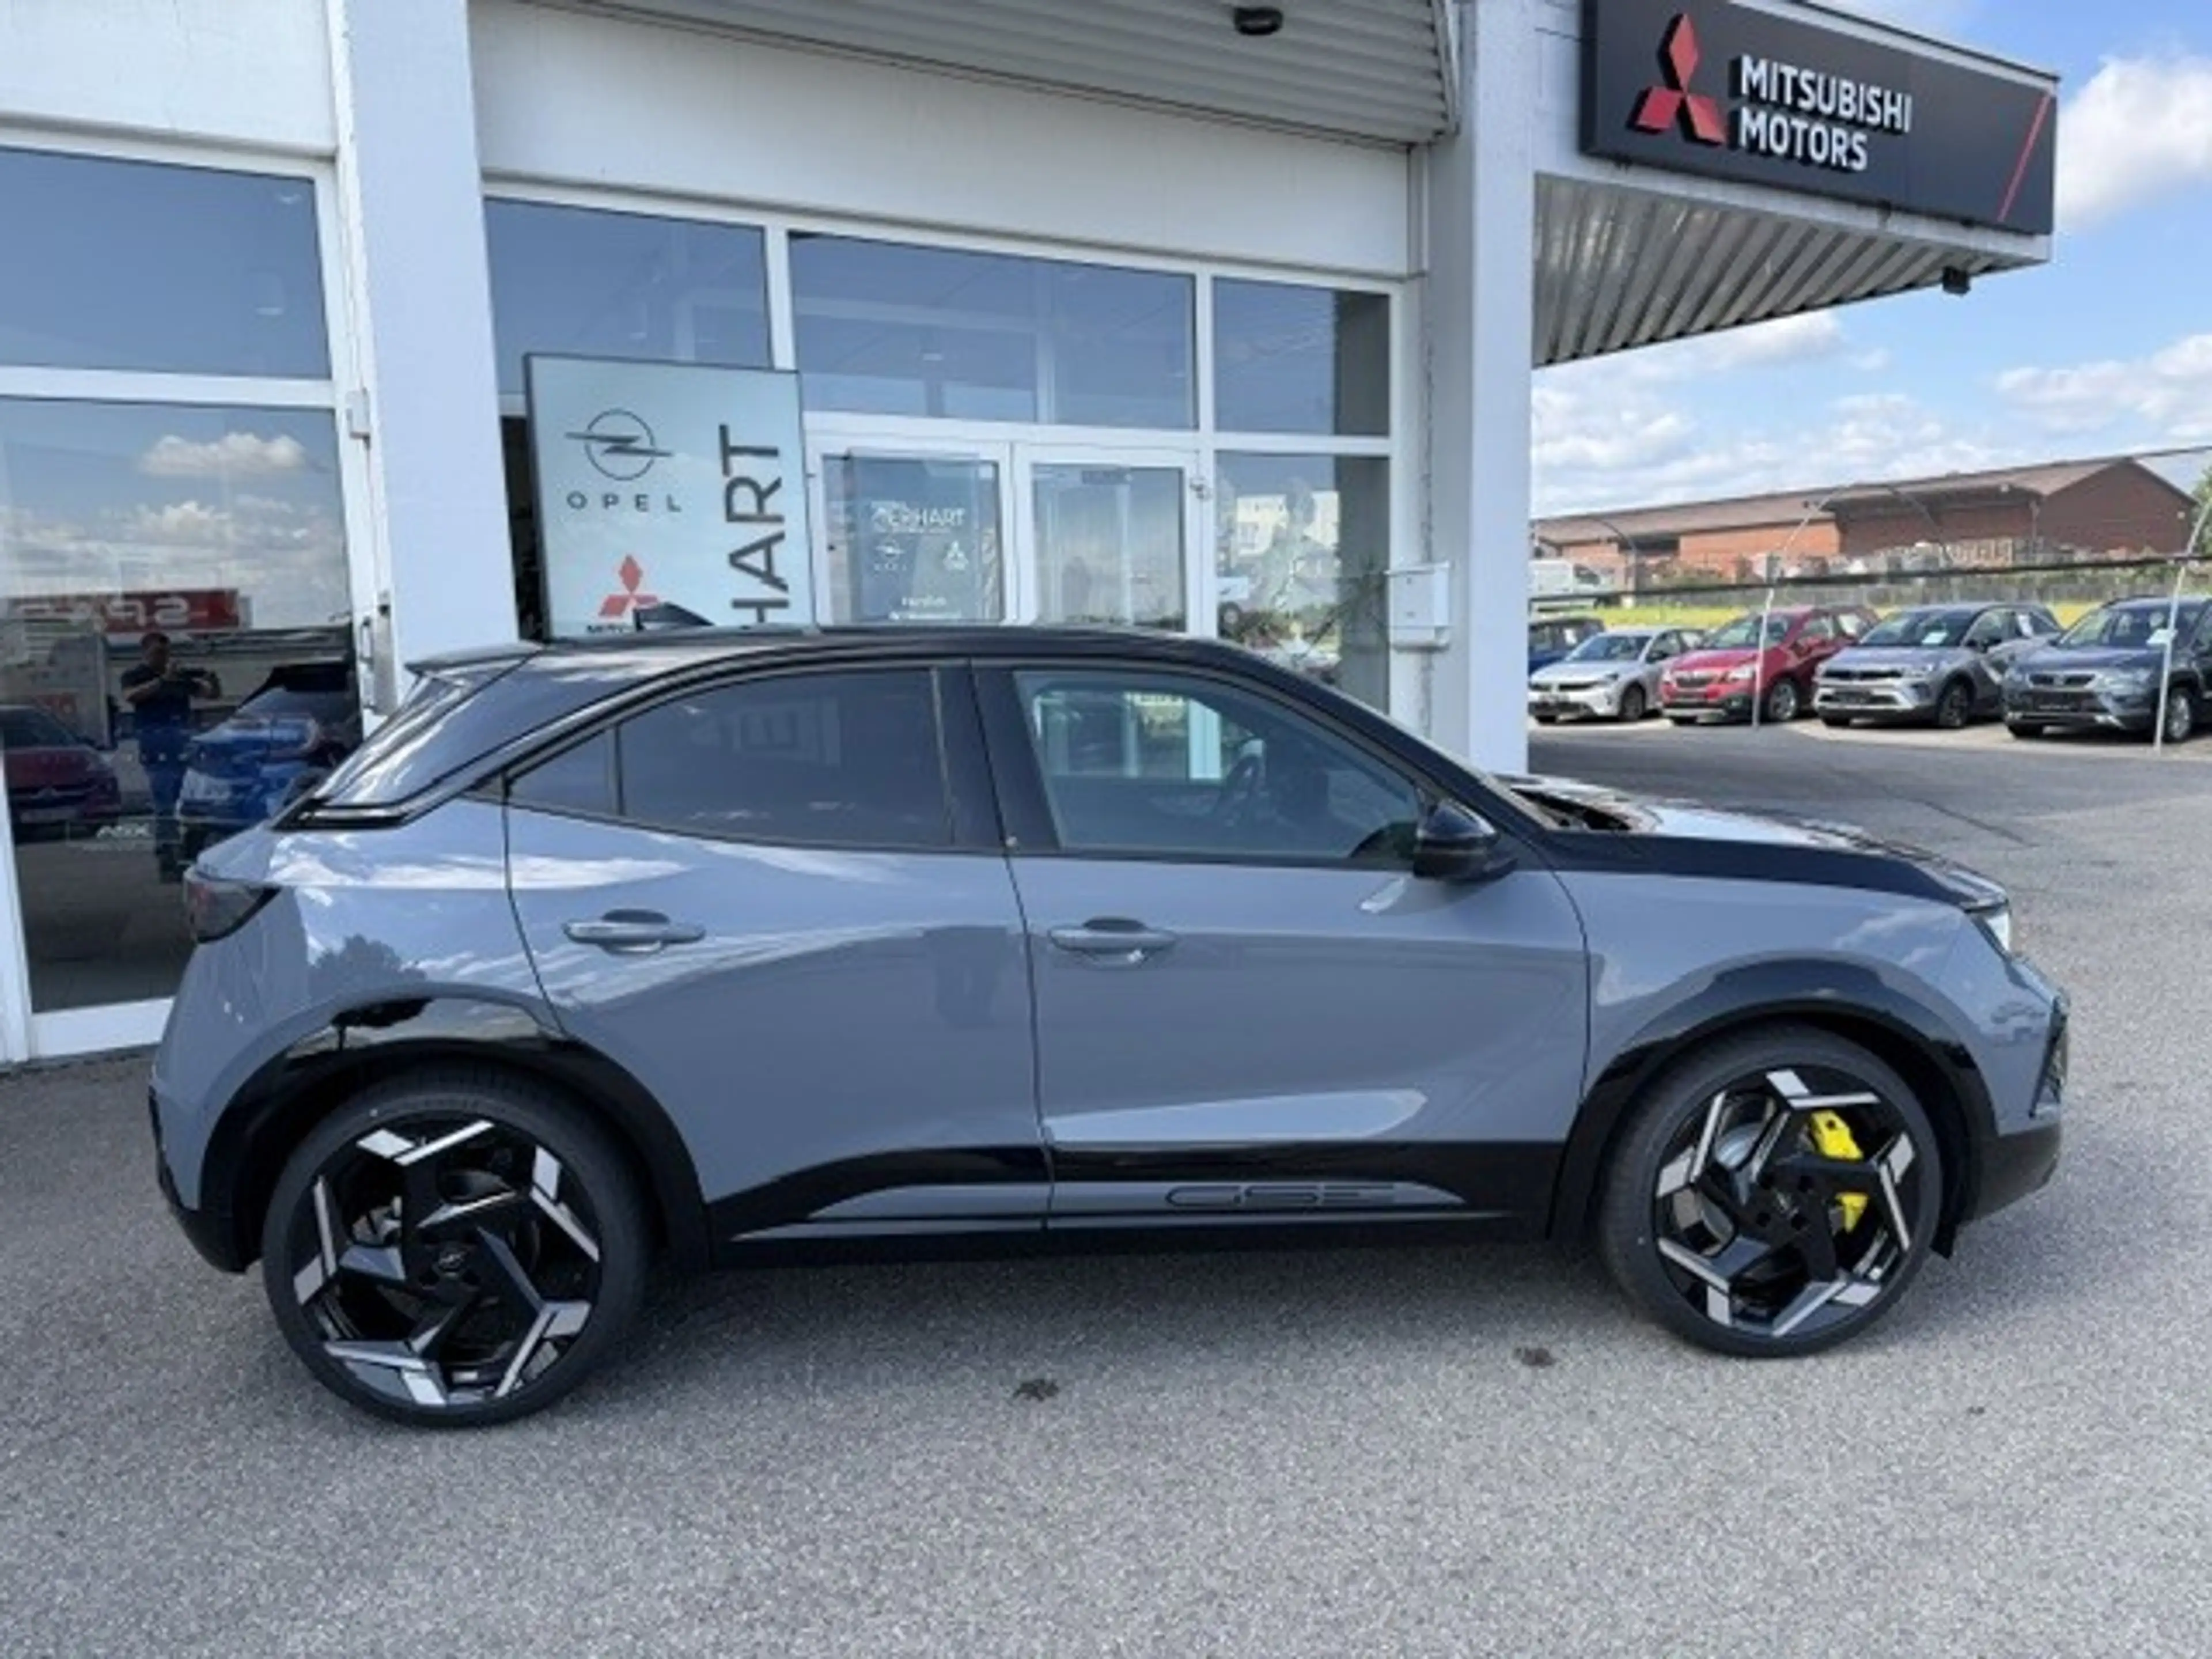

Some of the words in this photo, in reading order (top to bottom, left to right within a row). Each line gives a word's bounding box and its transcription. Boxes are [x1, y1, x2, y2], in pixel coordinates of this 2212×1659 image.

[1740, 55, 1912, 134] MITSUBISHI
[1739, 108, 1868, 171] MOTORS
[566, 490, 683, 512] OPEL
